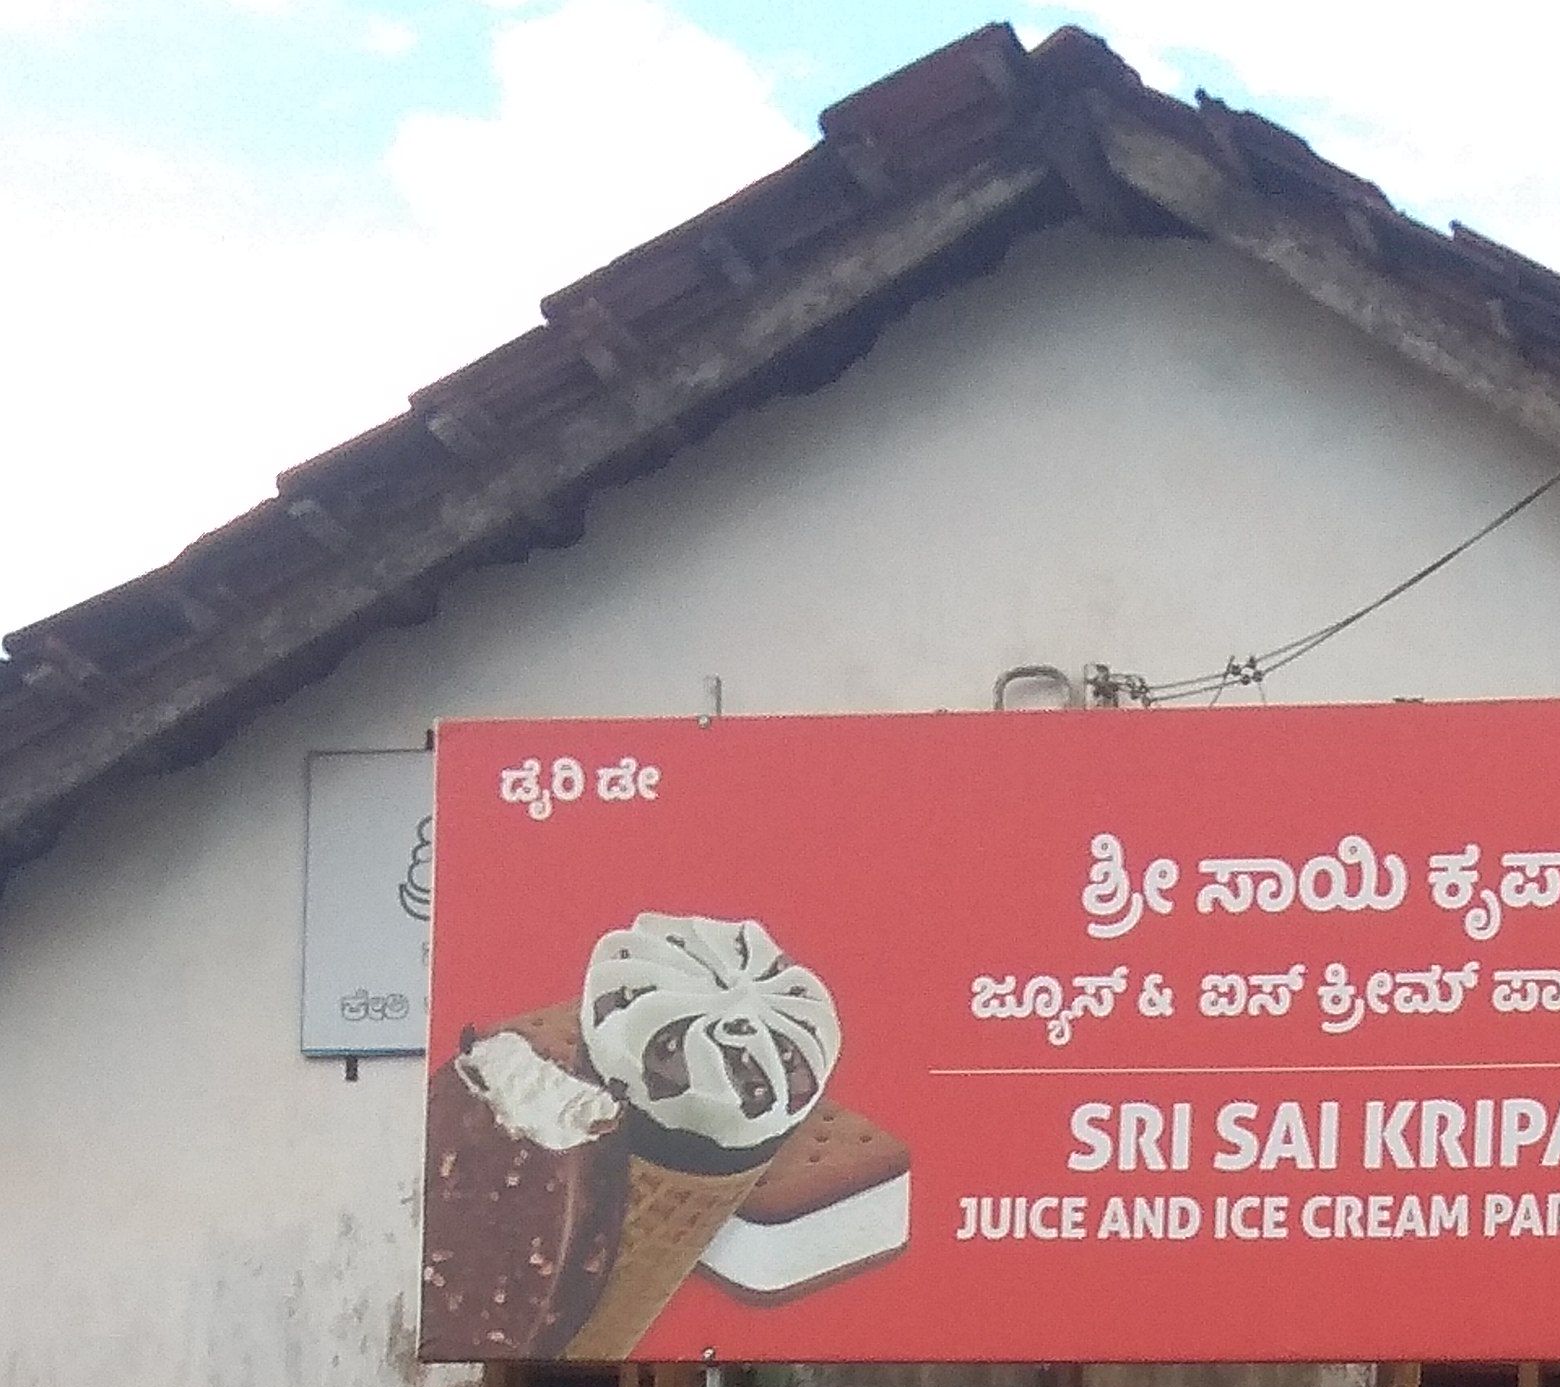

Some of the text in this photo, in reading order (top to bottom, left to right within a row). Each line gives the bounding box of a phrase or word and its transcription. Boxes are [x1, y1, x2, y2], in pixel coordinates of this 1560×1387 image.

[1083, 832, 1179, 938] ಶ್ರೀ
[1197, 835, 1407, 913] ಸಾಯಿ
[970, 964, 1130, 1046] ಜ್ಯೂಸ್
[1137, 974, 1175, 1017] &
[1200, 963, 1307, 1018] ಐಸ್
[1317, 960, 1480, 1034] ಕ್ರೀಮ್
[1067, 1102, 1190, 1173] SRI
[1212, 1100, 1338, 1171] SAI
[956, 1196, 1086, 1242] JUICE
[1097, 1195, 1201, 1241] AND
[1213, 1193, 1289, 1240] ICE
[1301, 1192, 1470, 1239] CREAM
